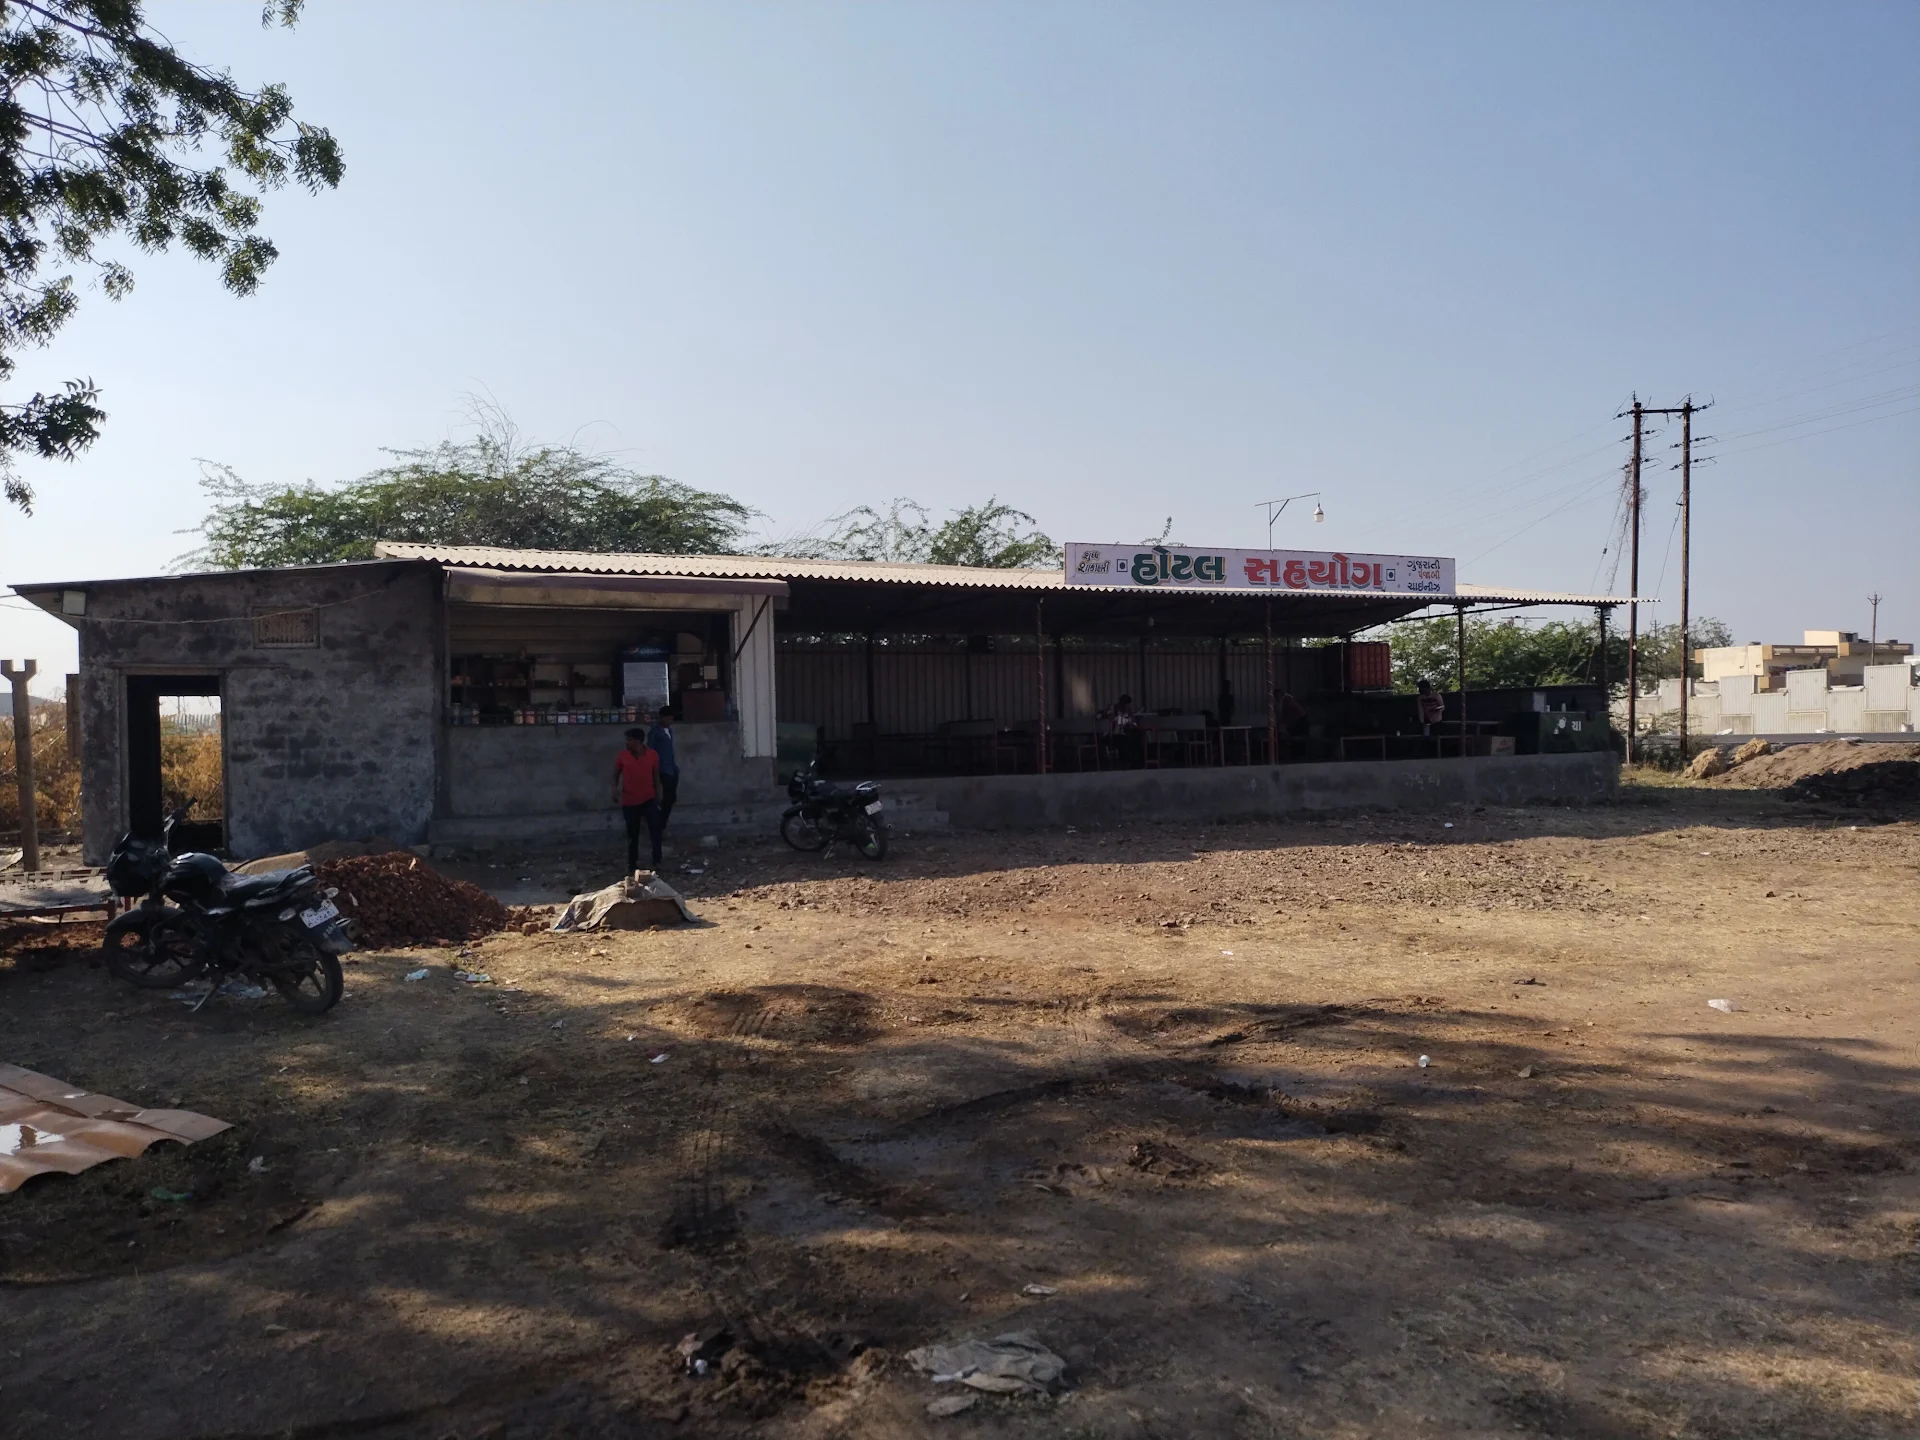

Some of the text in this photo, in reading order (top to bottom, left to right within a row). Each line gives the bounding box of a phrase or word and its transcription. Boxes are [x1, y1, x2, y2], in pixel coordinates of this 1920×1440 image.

[1131, 546, 1385, 590] હોટલ સહયોગ
[1407, 560, 1441, 572] ગુજરાતી
[1418, 569, 1441, 580] પંજાબી
